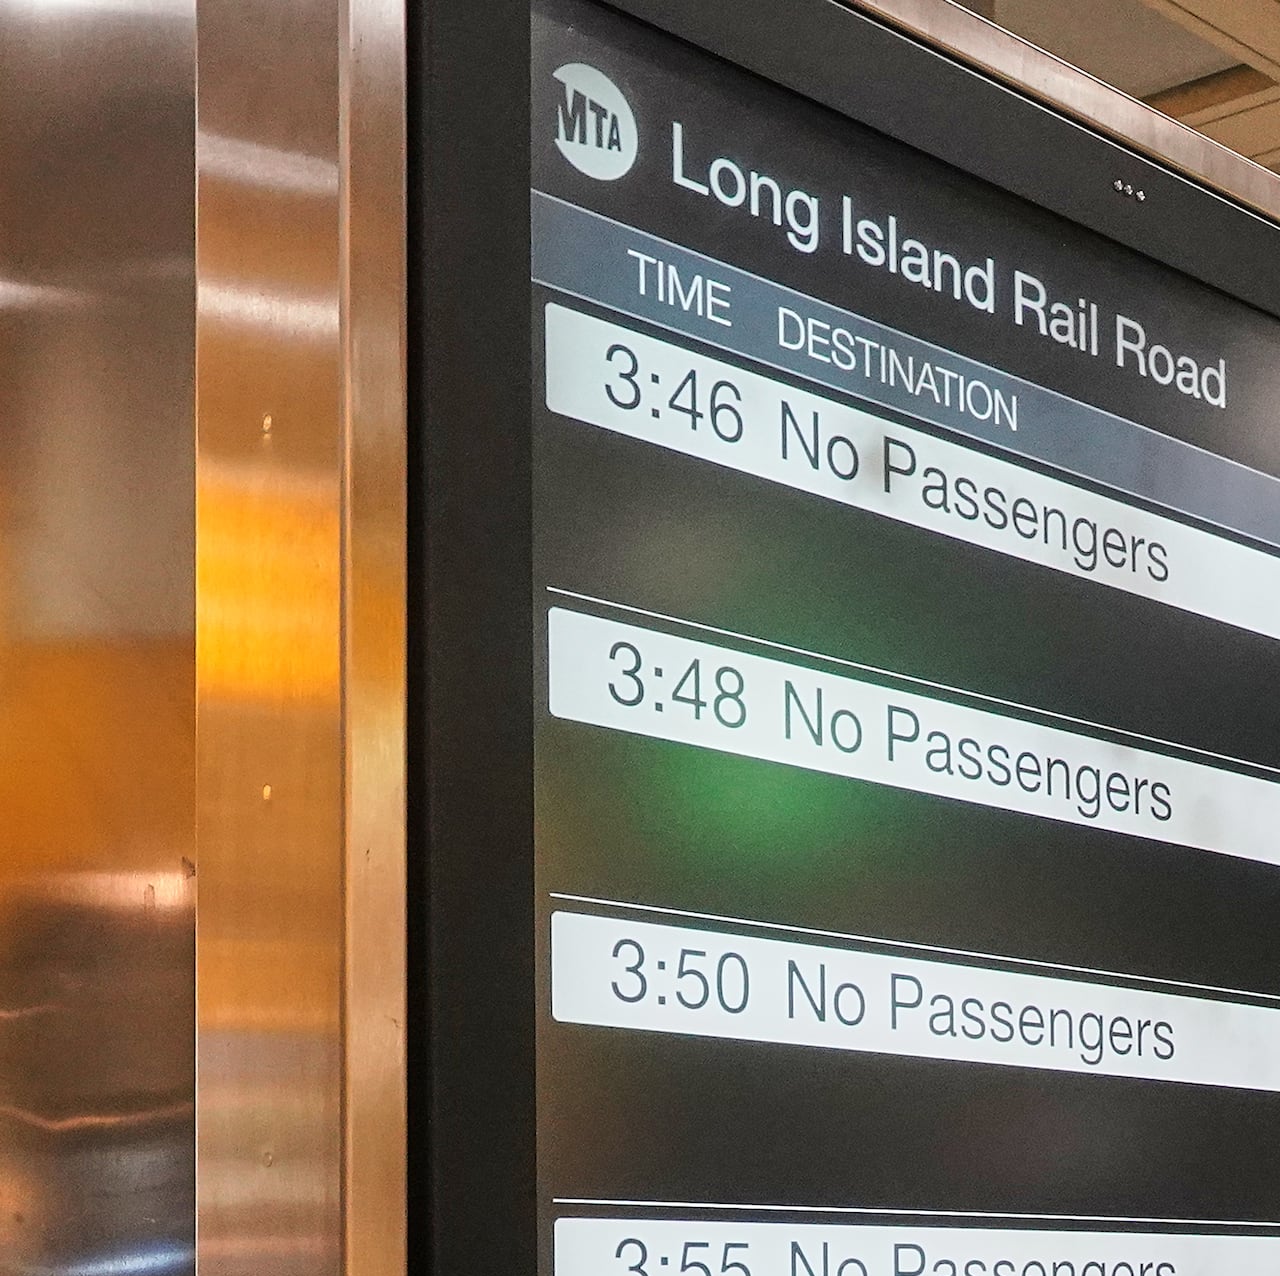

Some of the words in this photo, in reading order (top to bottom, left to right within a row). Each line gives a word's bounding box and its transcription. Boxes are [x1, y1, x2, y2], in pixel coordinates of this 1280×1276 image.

[556, 85, 621, 152] MTA
[628, 249, 731, 326] TIME
[778, 307, 1017, 431] DESTINATION
[673, 122, 818, 253] Long
[843, 196, 994, 313] Island
[1015, 271, 1097, 355] Rail
[1117, 315, 1226, 408] Road
[605, 344, 743, 442] 3:46
[781, 401, 859, 480] No
[884, 436, 1168, 581] Passengers
[609, 642, 746, 728] 3:48
[785, 680, 862, 753] No
[888, 705, 1171, 821] Passengers
[612, 939, 749, 1013] 3:50
[788, 960, 865, 1026] No
[892, 974, 1174, 1065] Passengers
